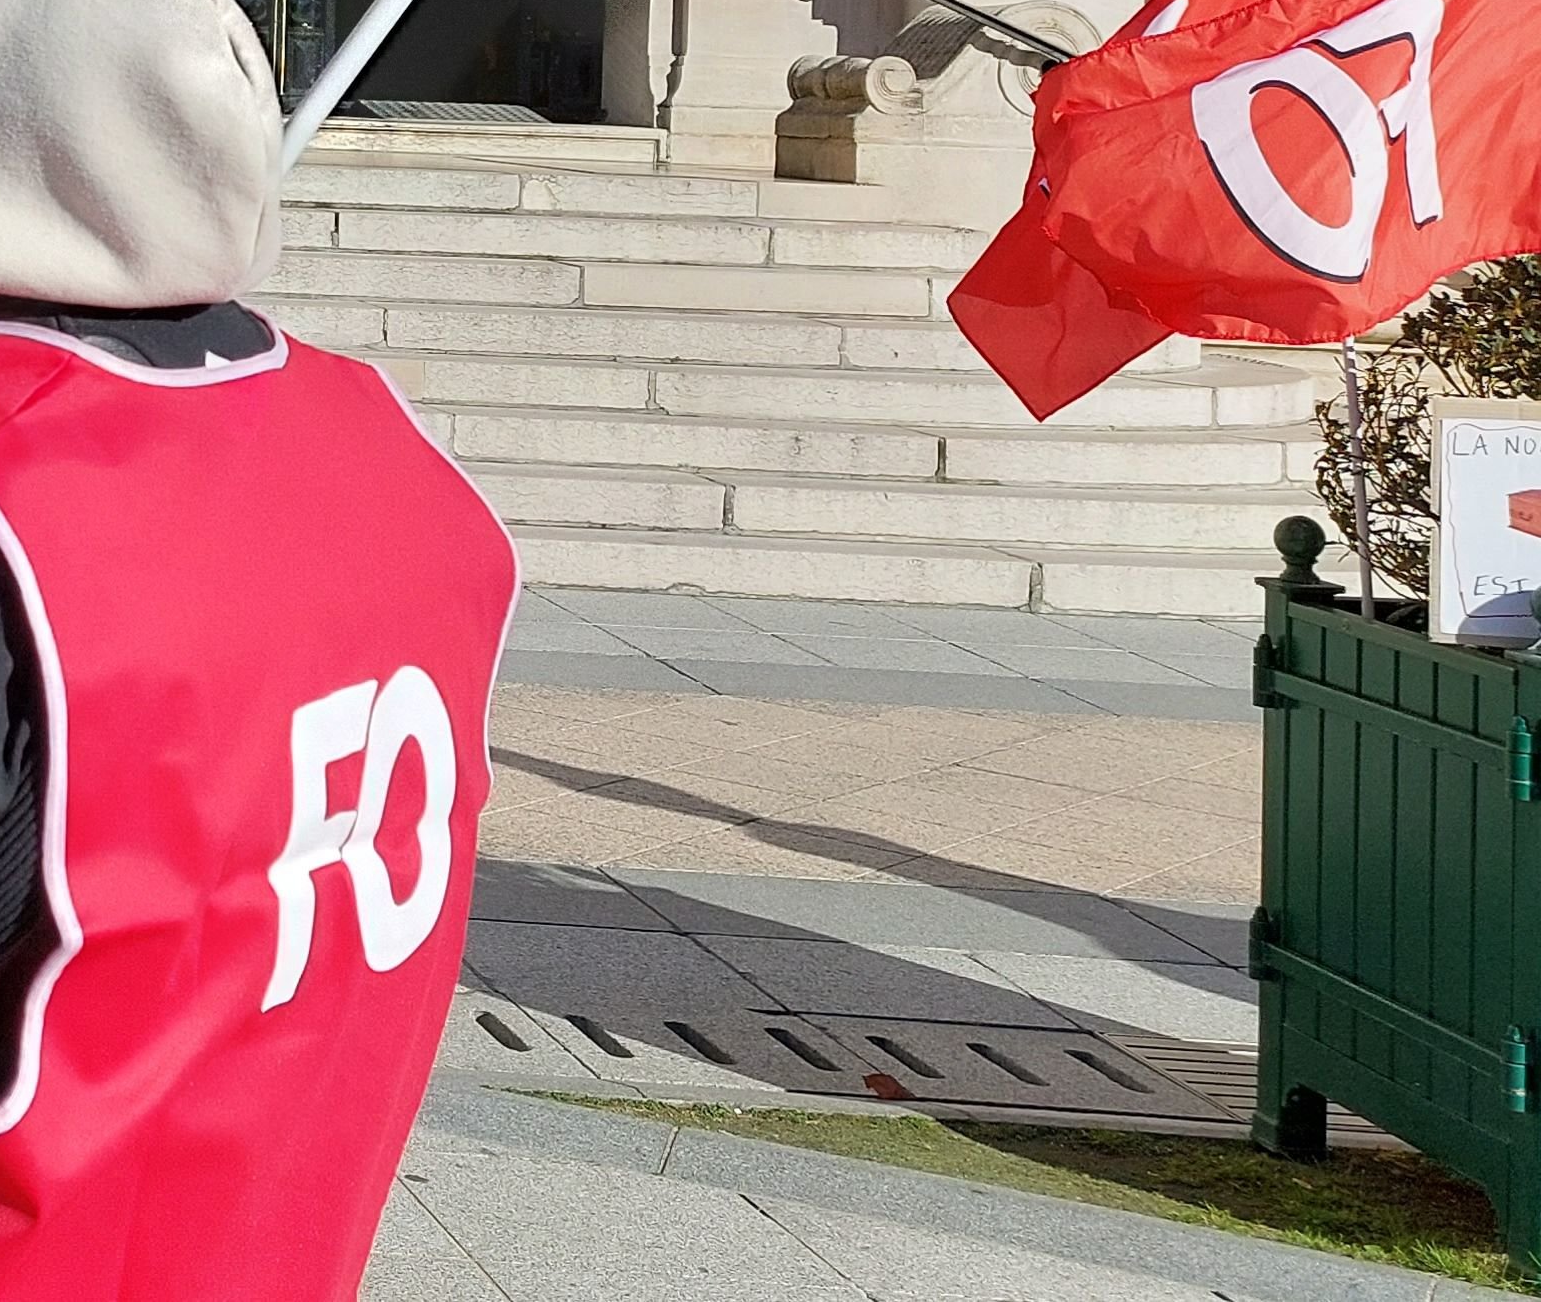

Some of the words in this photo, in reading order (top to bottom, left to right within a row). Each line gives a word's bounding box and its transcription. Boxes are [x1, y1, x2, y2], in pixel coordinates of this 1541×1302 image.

[1452, 432, 1488, 456] LA
[1505, 435, 1541, 455] NO
[1473, 574, 1531, 596] EST
[261, 665, 457, 1013] FO
